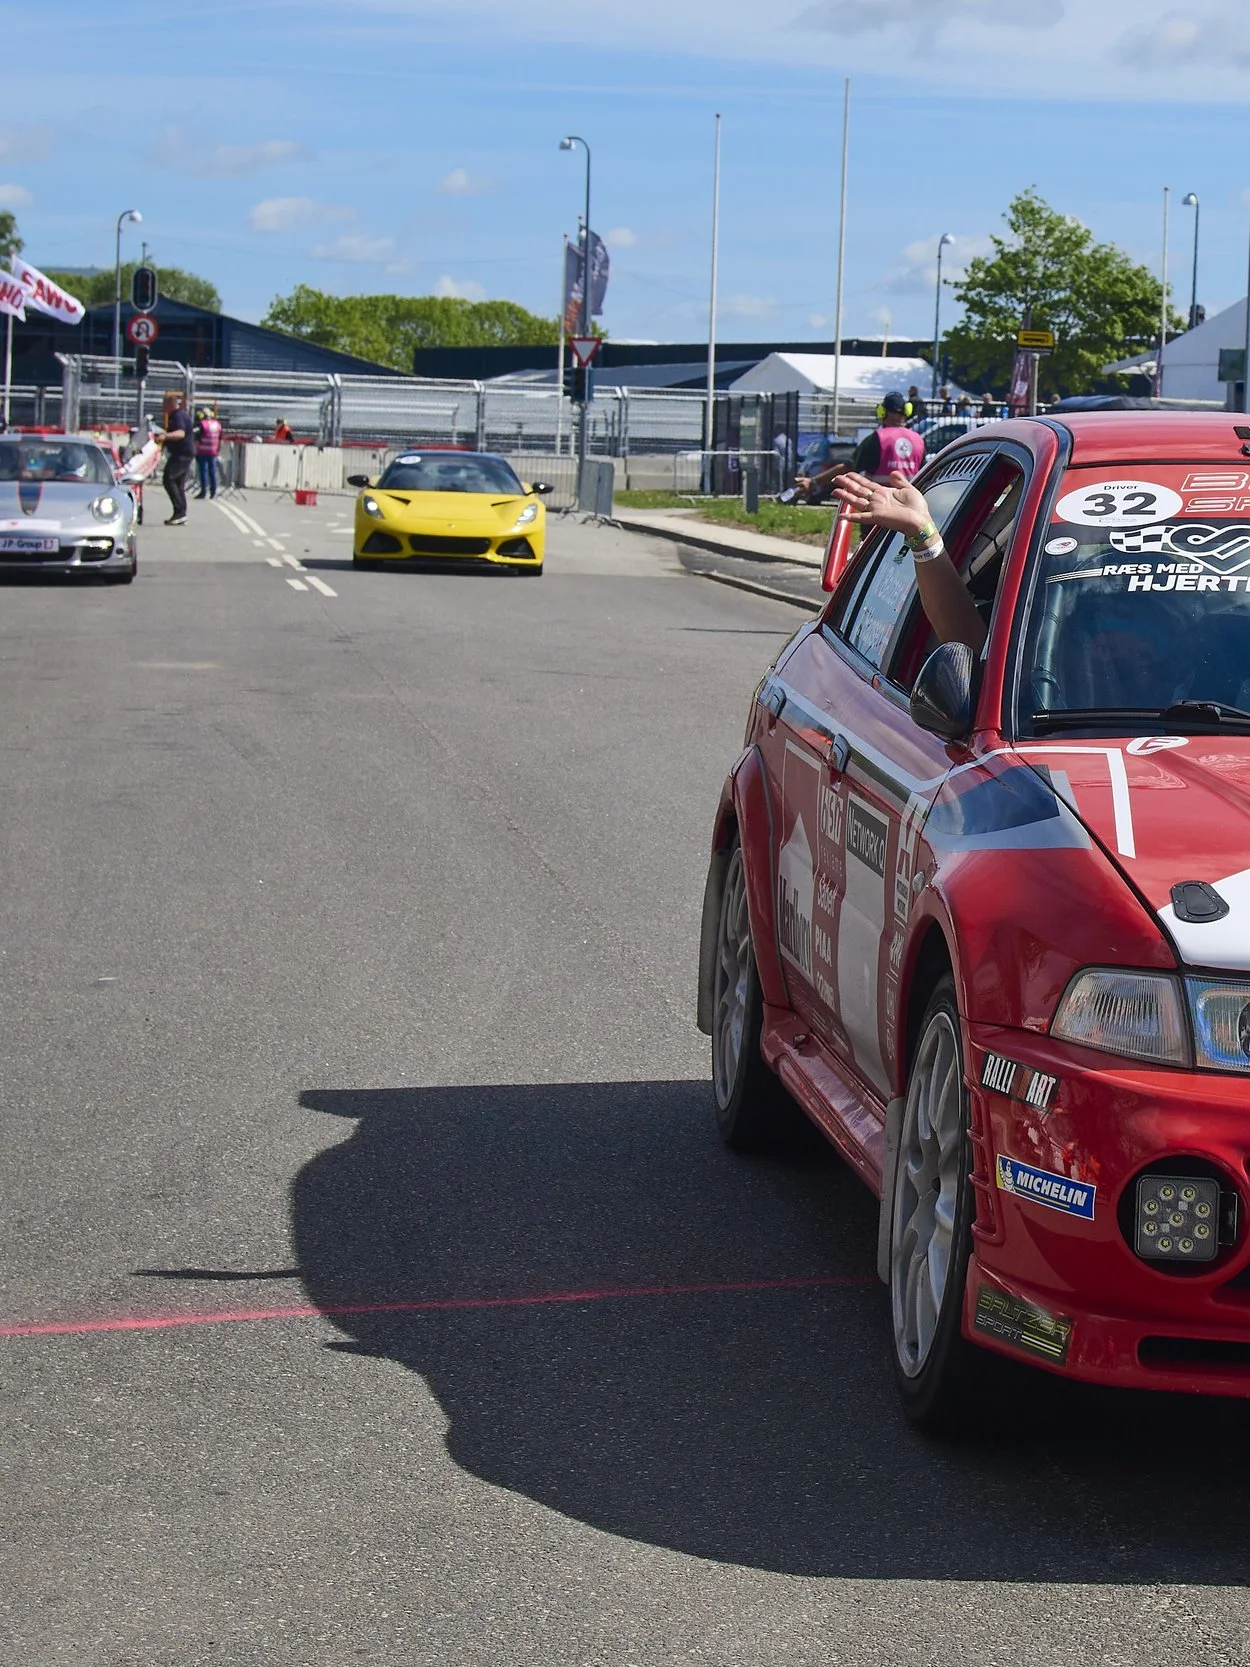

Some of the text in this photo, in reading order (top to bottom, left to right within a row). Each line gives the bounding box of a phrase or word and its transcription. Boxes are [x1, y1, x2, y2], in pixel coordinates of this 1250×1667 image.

[1082, 491, 1157, 516] 32
[17, 541, 42, 551] Group
[1103, 563, 1204, 575] RÆS MED
[849, 808, 885, 870] NETWORK Q
[816, 924, 833, 968] PIAA
[982, 1054, 1056, 1108] RALLI ART
[1016, 1170, 1088, 1206] MICHELIN
[976, 1313, 1022, 1340] SPORT
[978, 1292, 1071, 1343] BALTZER
